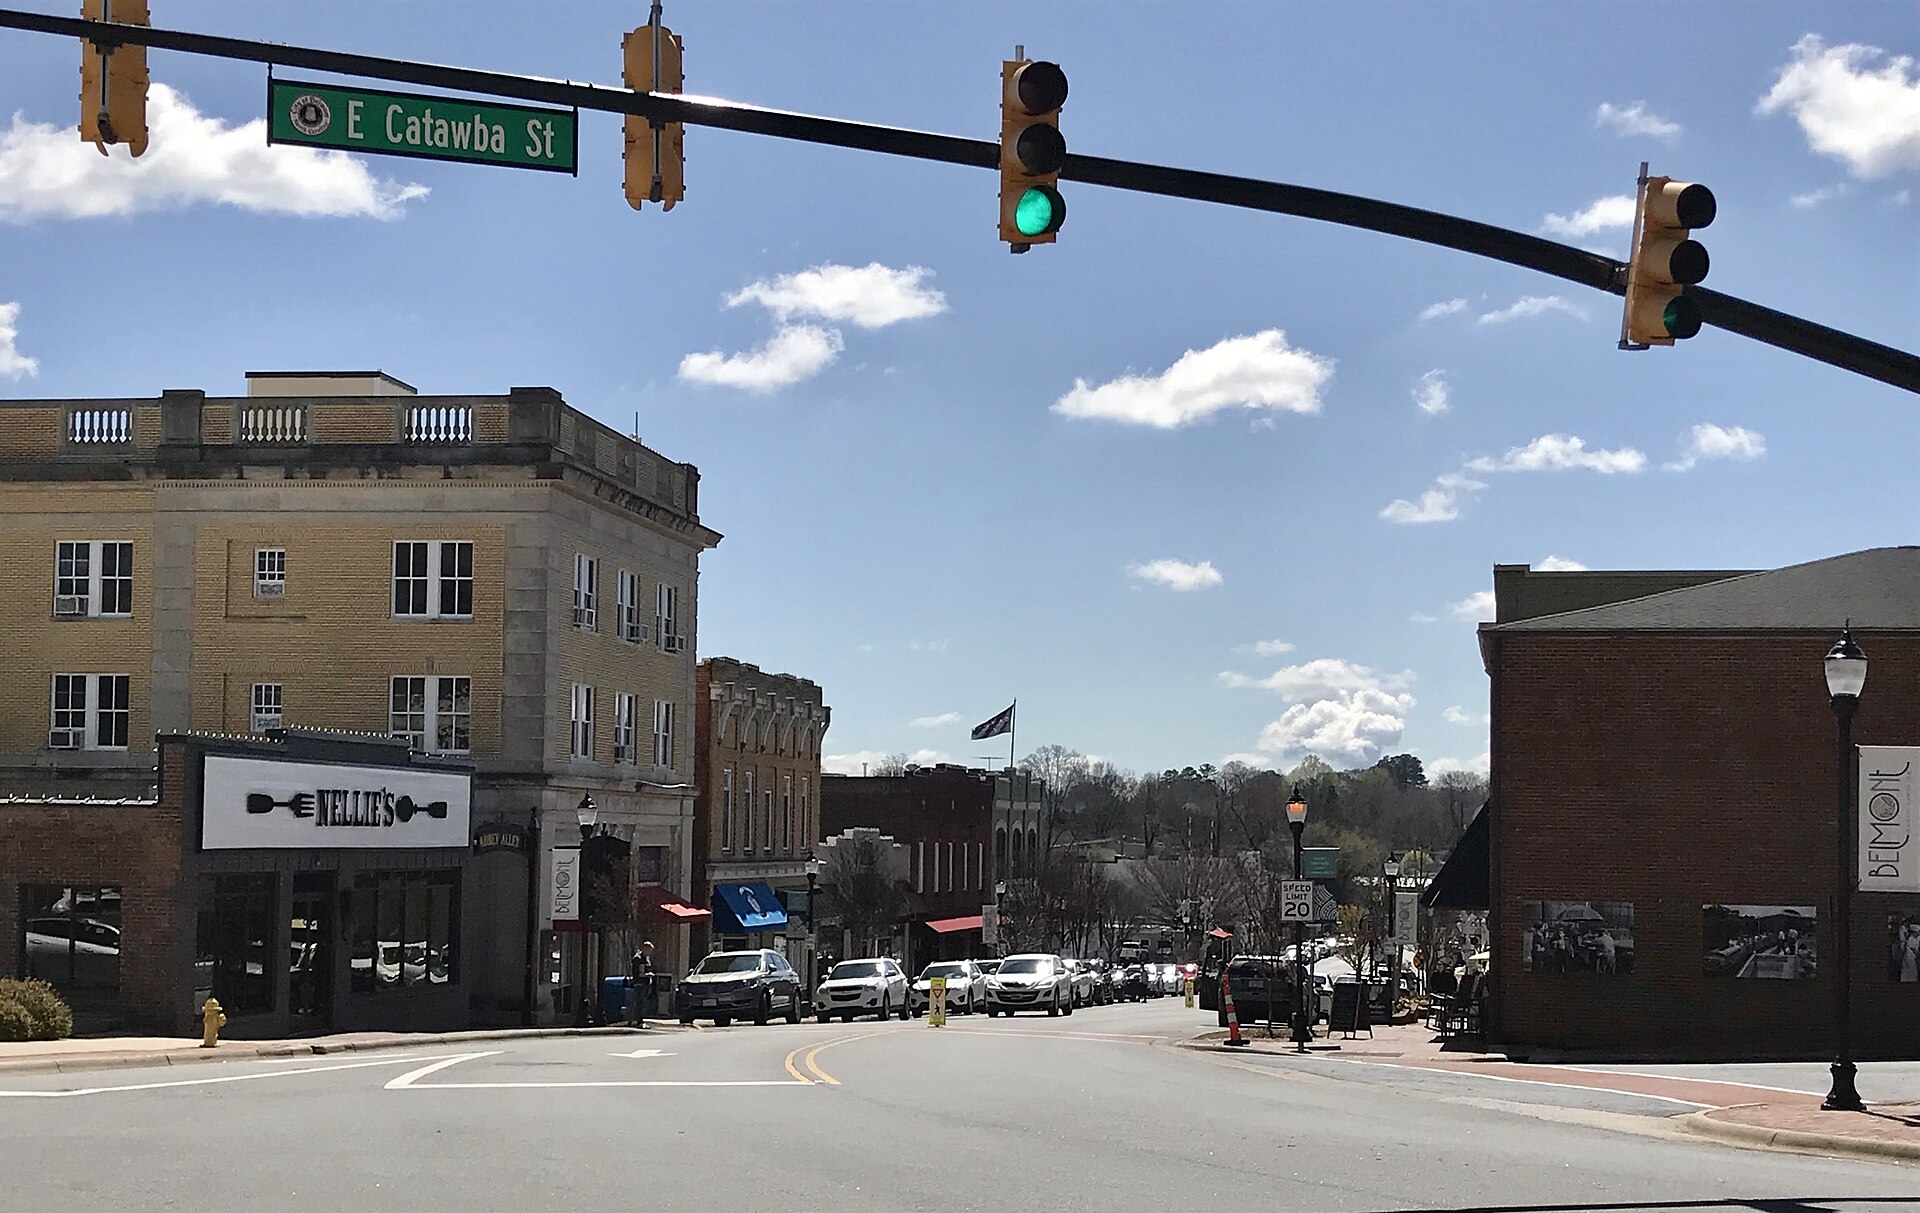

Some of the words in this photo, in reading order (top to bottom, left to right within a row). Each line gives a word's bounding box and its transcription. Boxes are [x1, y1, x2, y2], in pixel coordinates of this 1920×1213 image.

[348, 99, 364, 140] E
[385, 103, 505, 154] Catawba
[525, 119, 555, 159] St
[316, 785, 395, 828] NELLIE'S
[1283, 883, 1311, 892] SPEED
[1286, 893, 1308, 901] LIMIT
[1284, 901, 1310, 918] 20
